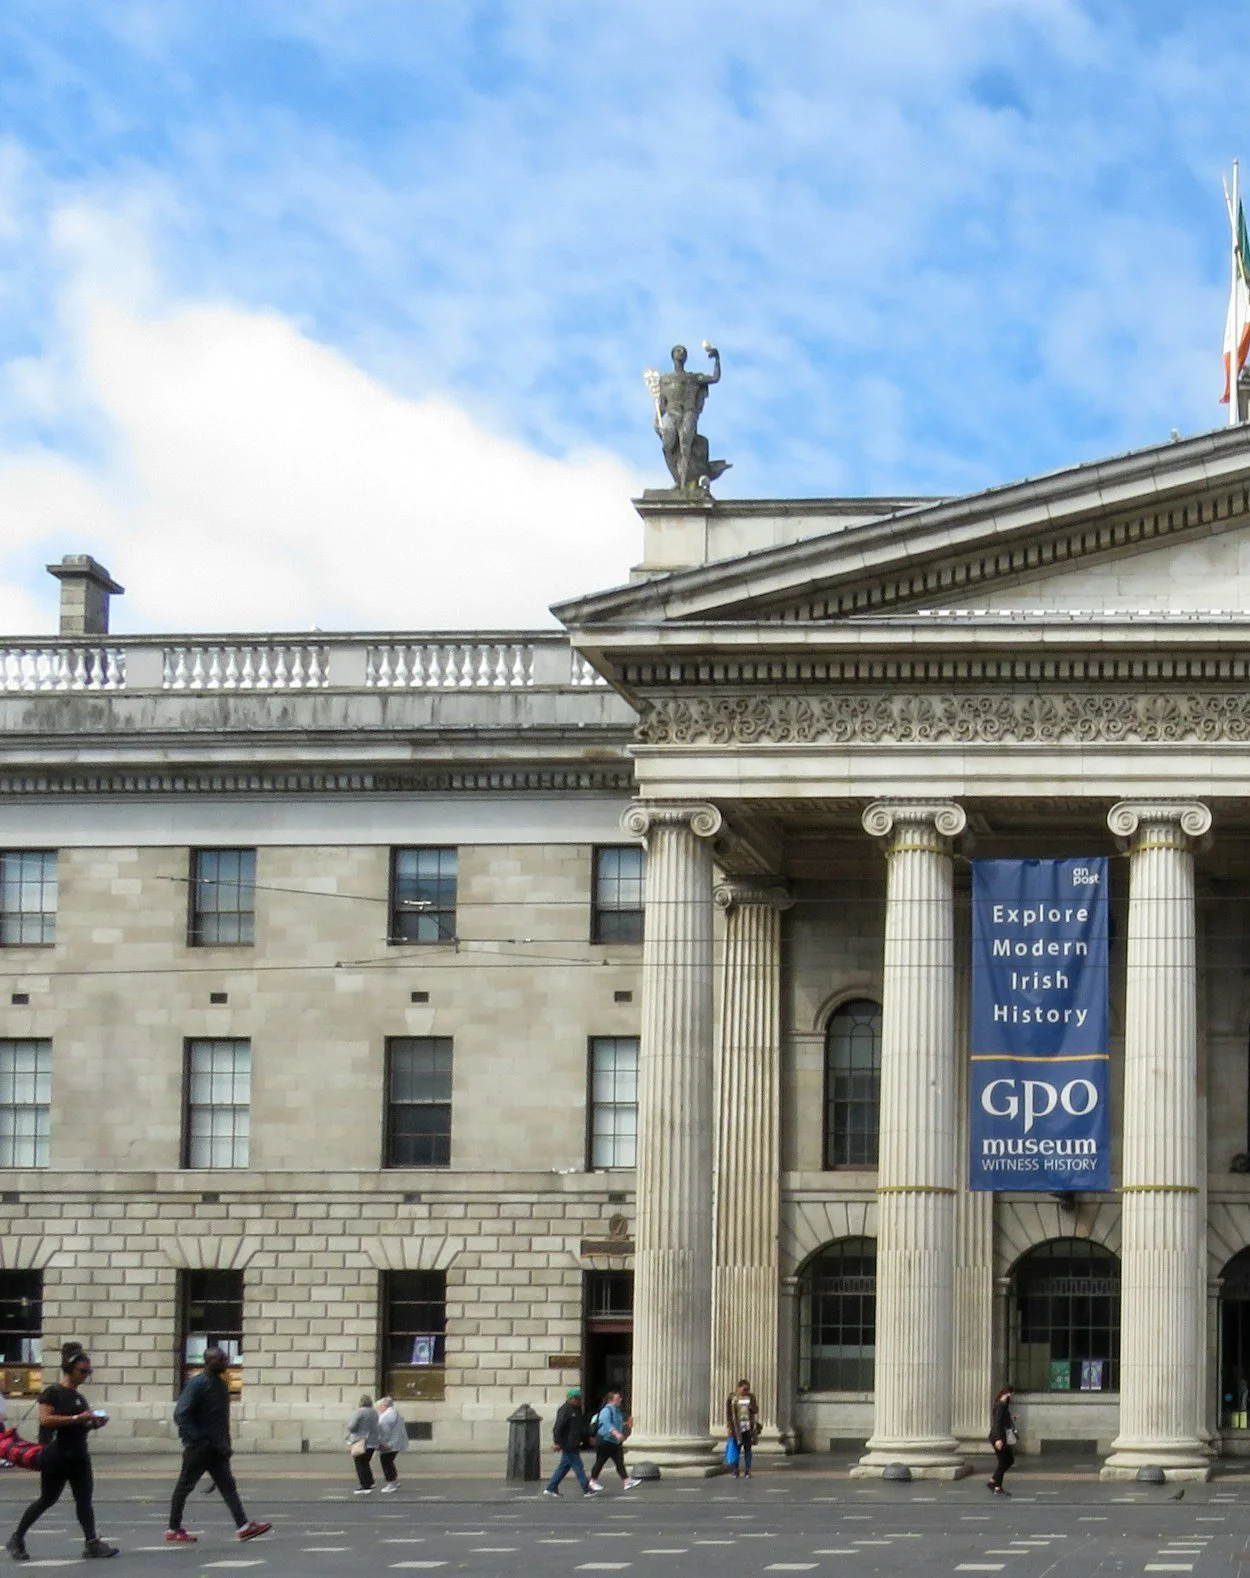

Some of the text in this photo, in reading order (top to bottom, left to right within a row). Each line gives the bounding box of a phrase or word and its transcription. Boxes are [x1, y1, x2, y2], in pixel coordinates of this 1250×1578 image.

[1073, 867, 1089, 876] an
[1073, 875, 1099, 886] post
[993, 904, 1088, 926] Explore
[993, 939, 1088, 956] Modern
[1012, 970, 1069, 990] Irish
[994, 1004, 1088, 1027] History
[981, 1079, 1098, 1134] GPO
[982, 1138, 1097, 1156] museum
[982, 1158, 1097, 1170] WITNESS HISTORY
